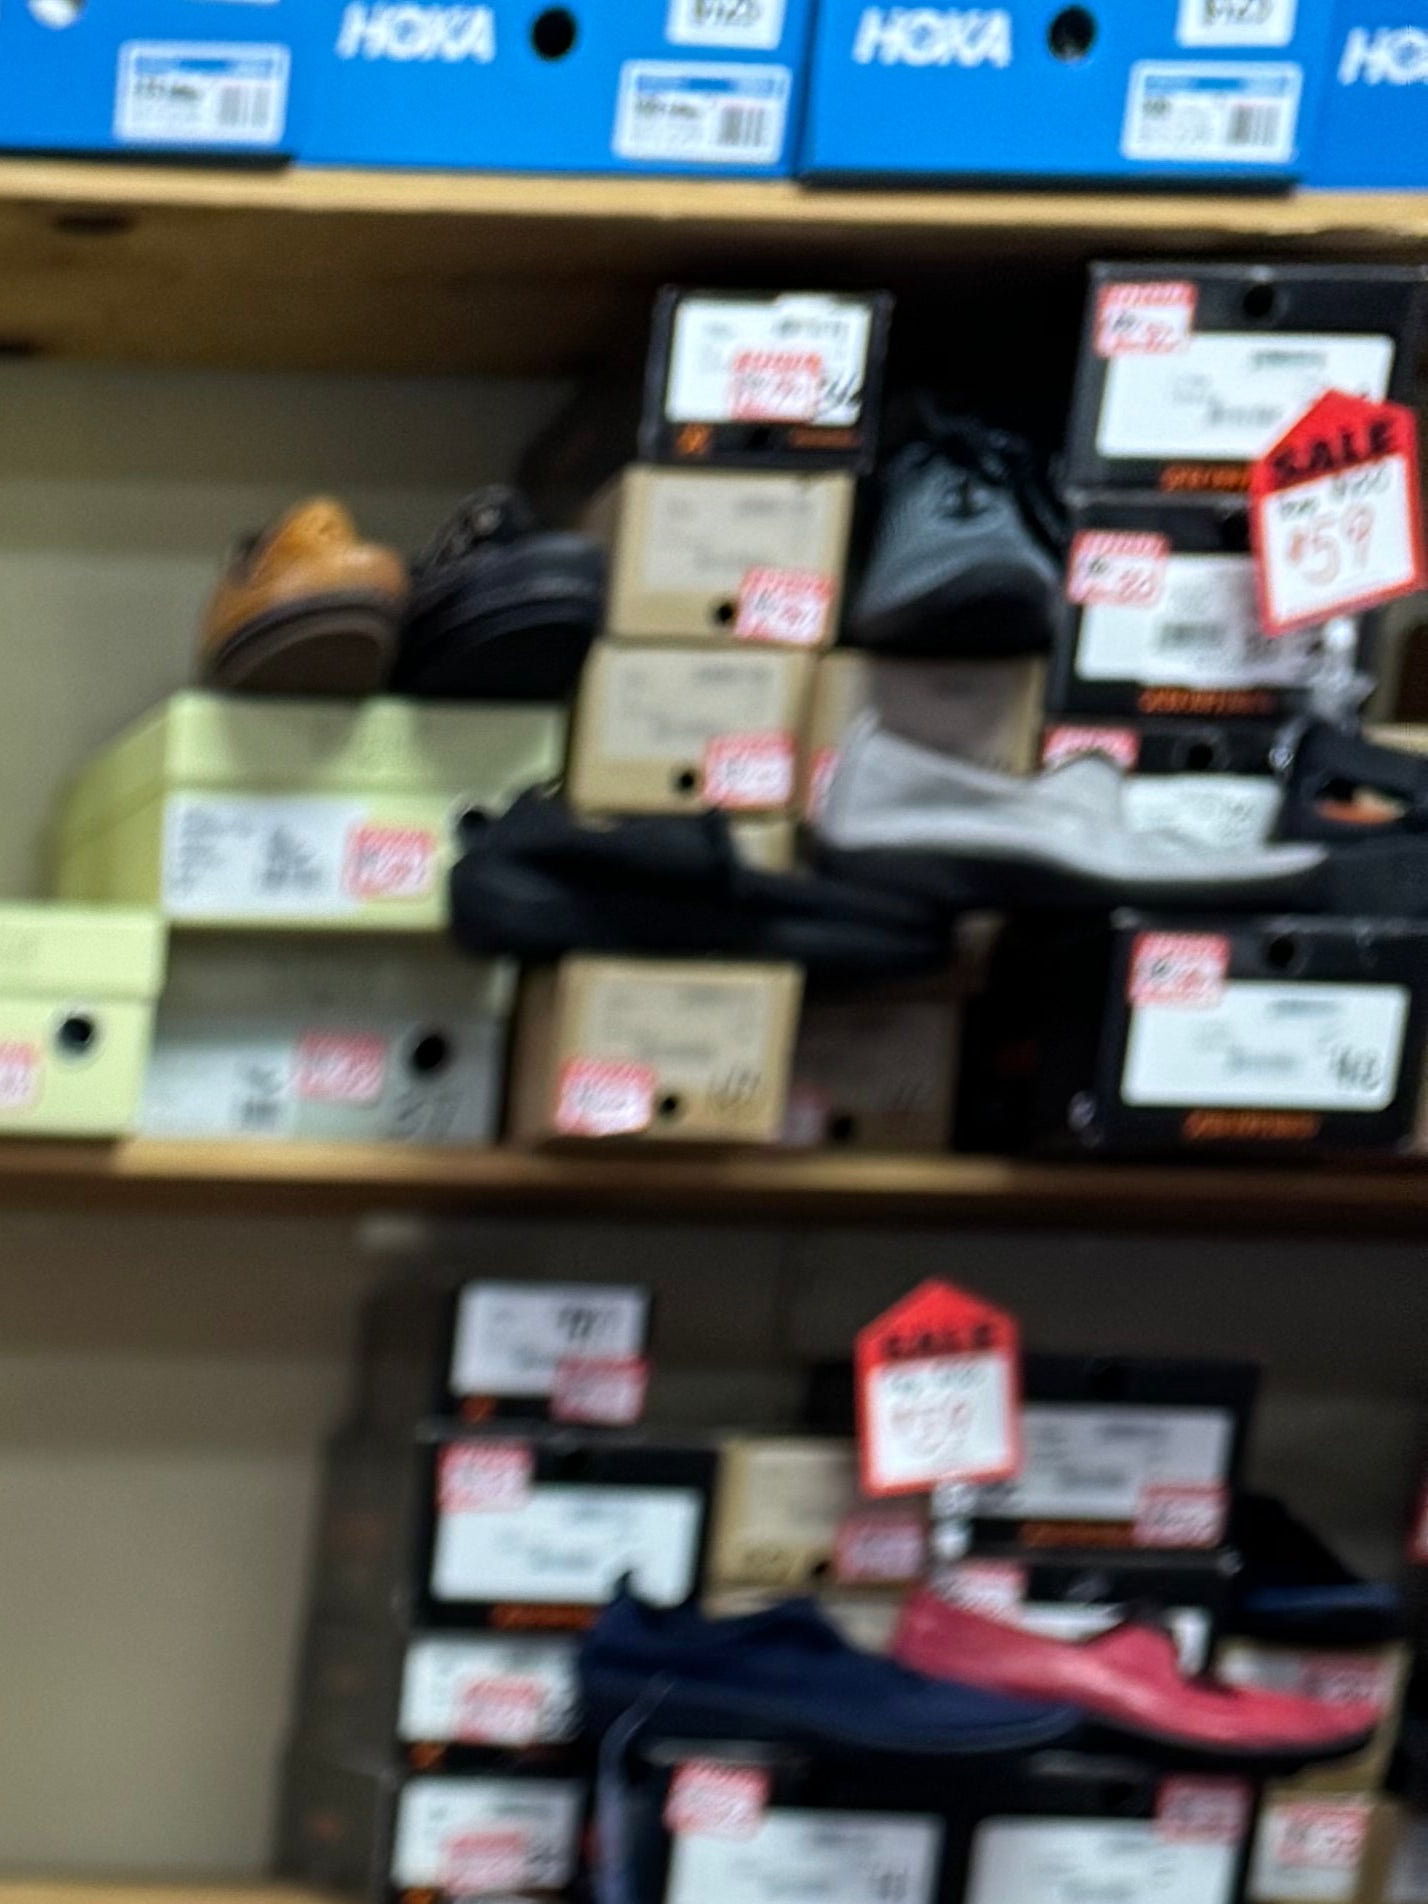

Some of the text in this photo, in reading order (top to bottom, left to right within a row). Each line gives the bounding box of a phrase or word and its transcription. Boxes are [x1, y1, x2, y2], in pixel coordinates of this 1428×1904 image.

[335, 3, 495, 65] HOKA
[850, 5, 1012, 69] HOKA
[1336, 24, 1428, 87] HO
[1272, 419, 1394, 482] SALE
